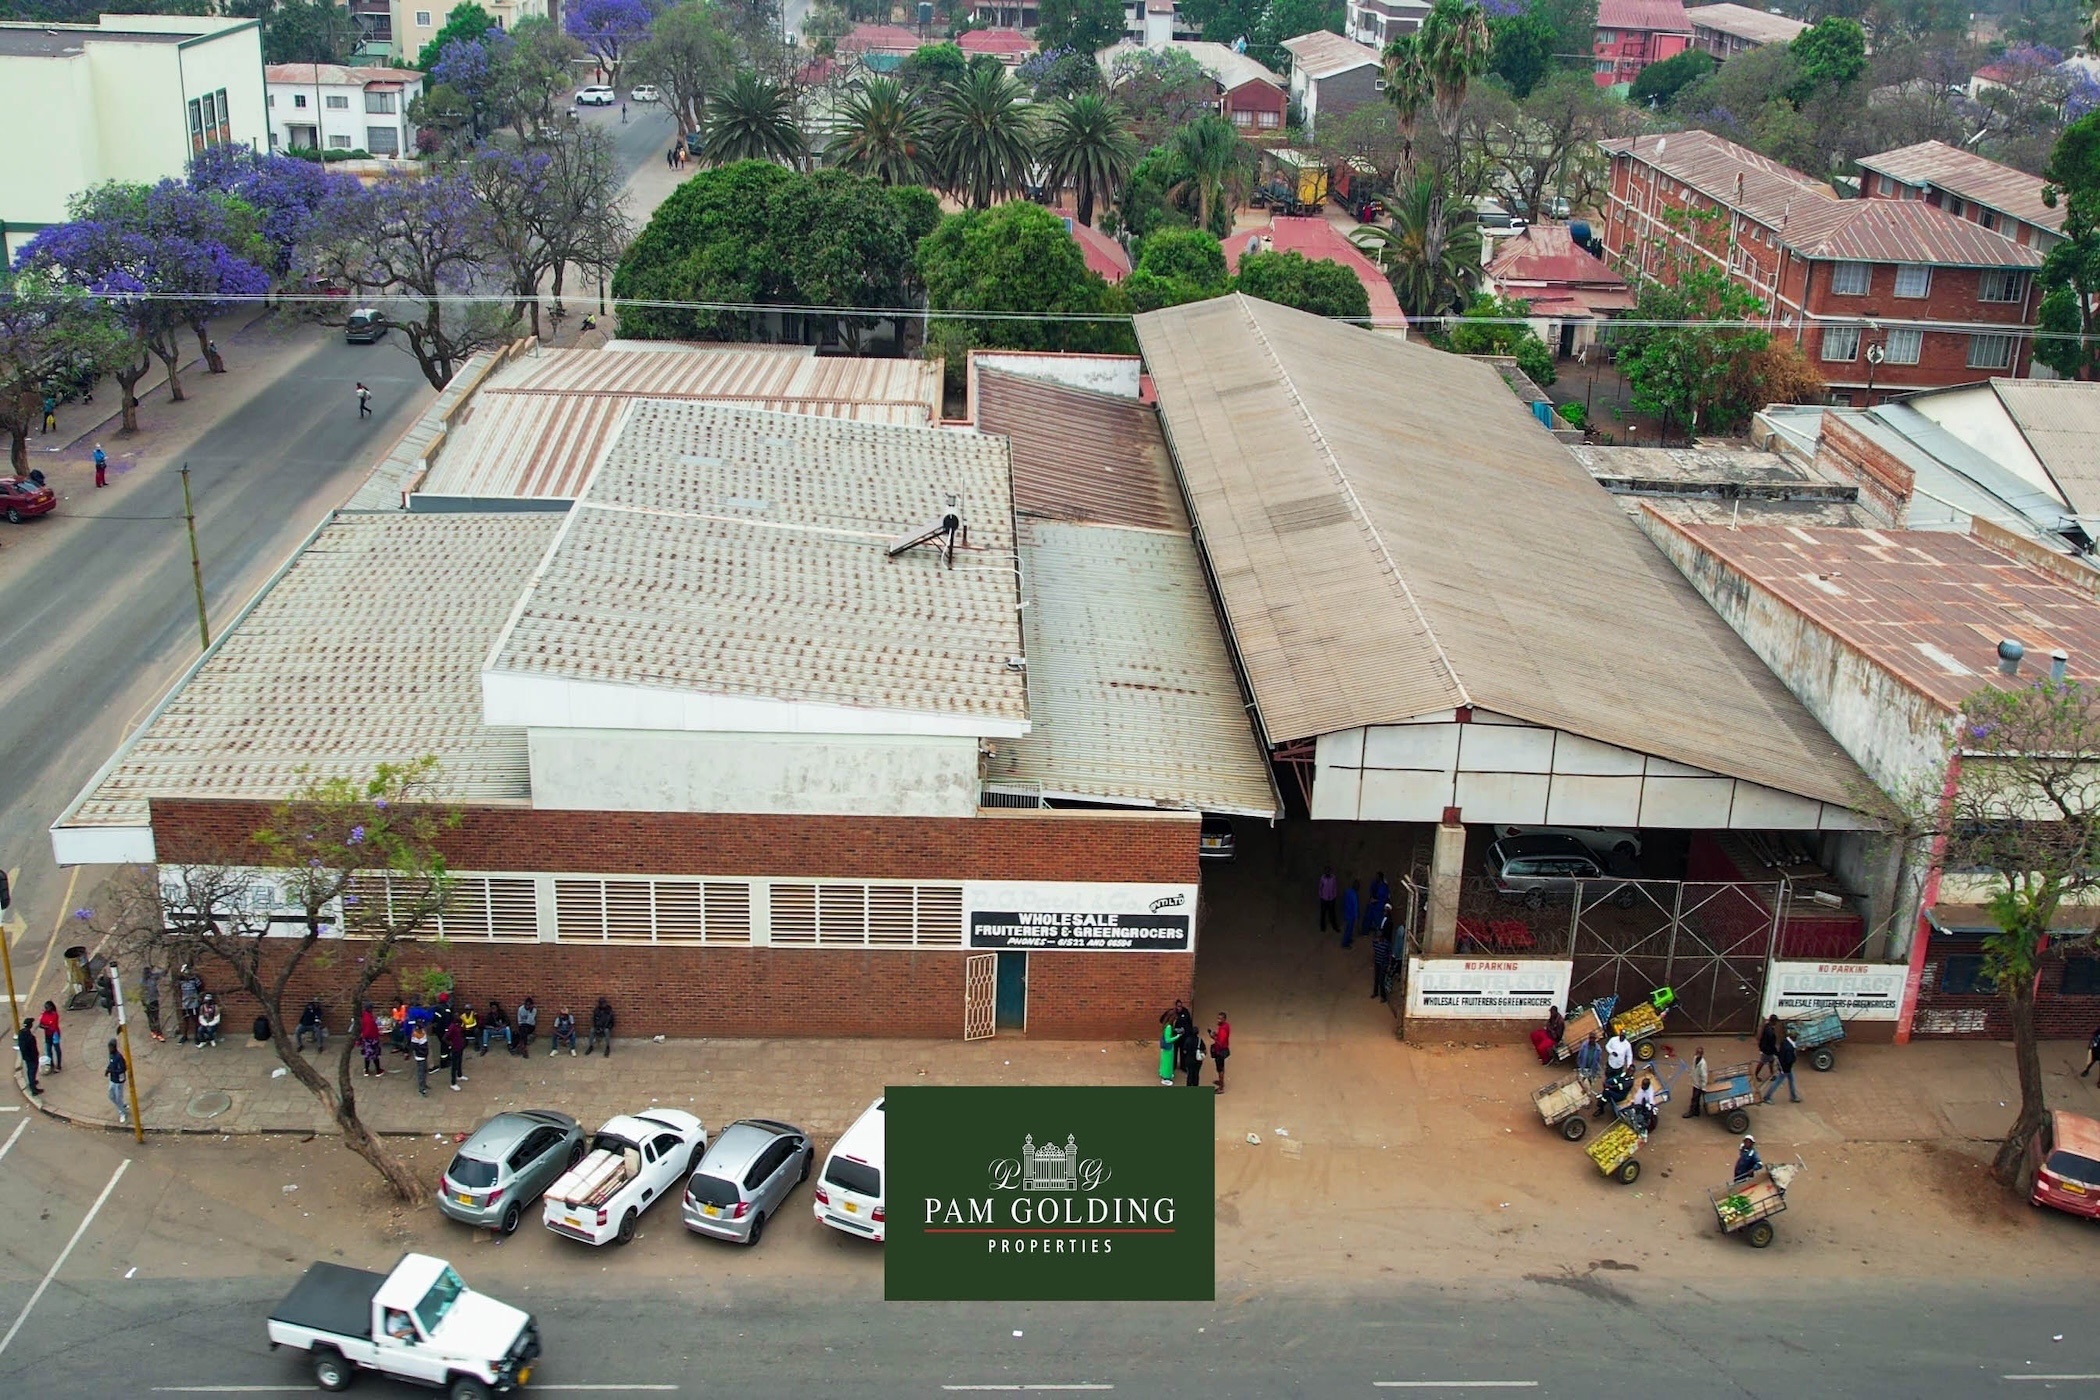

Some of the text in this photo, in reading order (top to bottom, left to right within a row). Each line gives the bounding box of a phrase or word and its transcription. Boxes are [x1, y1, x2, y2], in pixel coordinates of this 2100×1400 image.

[1018, 912, 1119, 927] WHOLESALE
[974, 924, 1184, 939] FRUITERERS & GREENGROCERS
[1086, 939, 1106, 947] AND
[1465, 962, 1519, 971] NO PARKING
[1818, 964, 1869, 974] NO PARKING
[1423, 997, 1460, 1006] WHOLESALE
[1461, 997, 1497, 1006] FRUITERERS
[1778, 998, 1813, 1008] WHOLESALE
